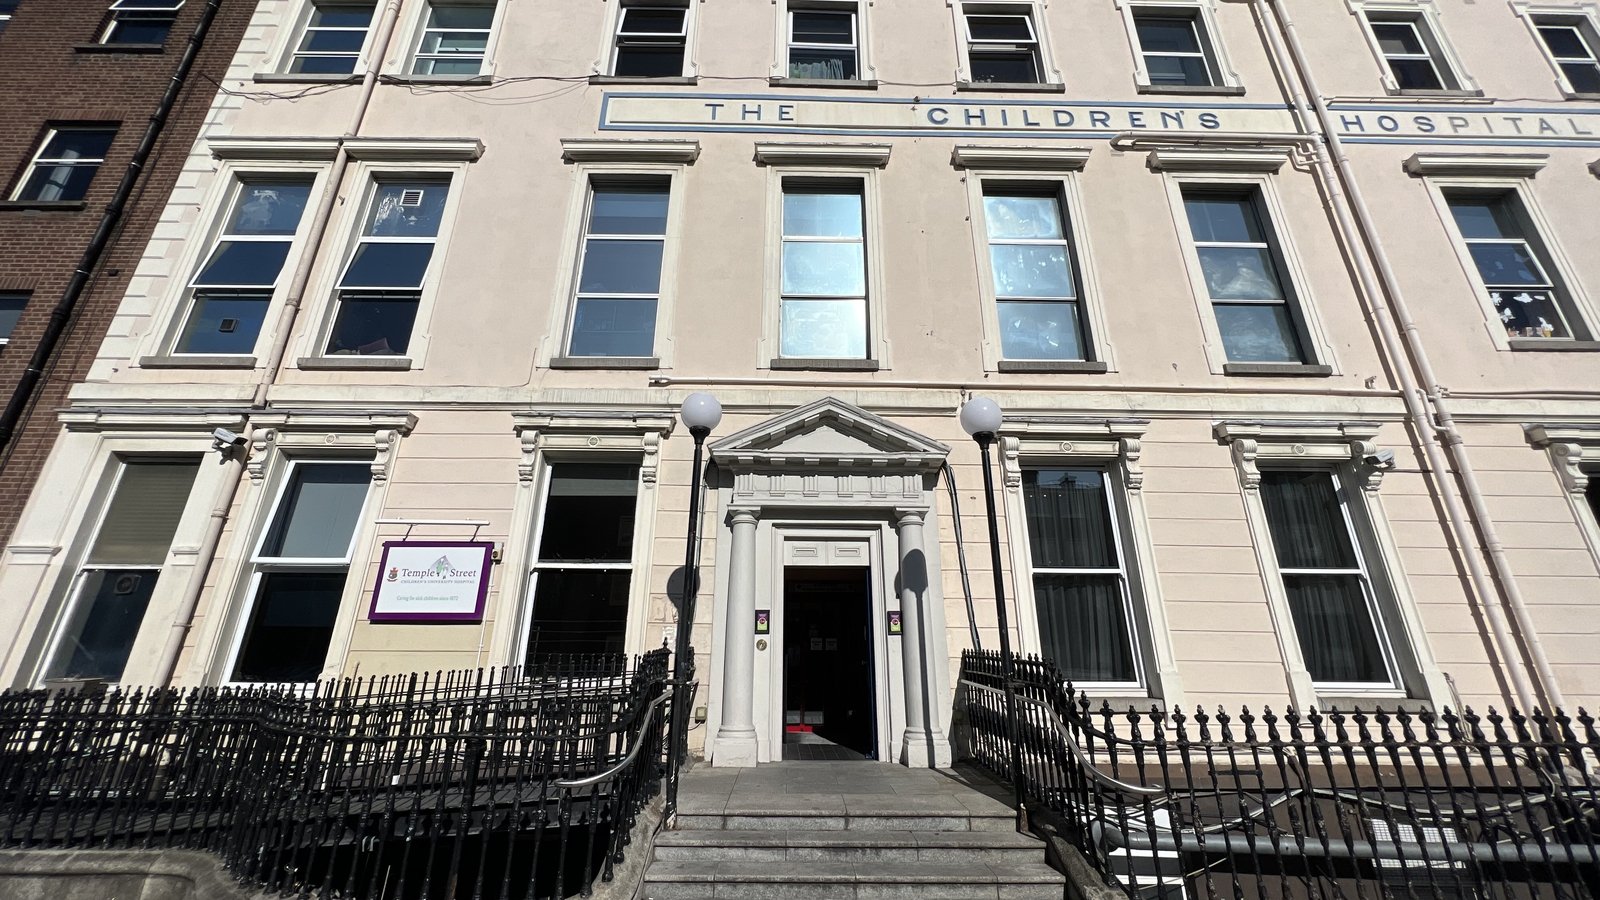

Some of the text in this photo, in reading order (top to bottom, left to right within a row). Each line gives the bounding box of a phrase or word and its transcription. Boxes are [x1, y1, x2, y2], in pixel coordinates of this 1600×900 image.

[704, 103, 1593, 135] THE CHILDREN'S HOSPITAL
[401, 568, 477, 579] Temple Street
